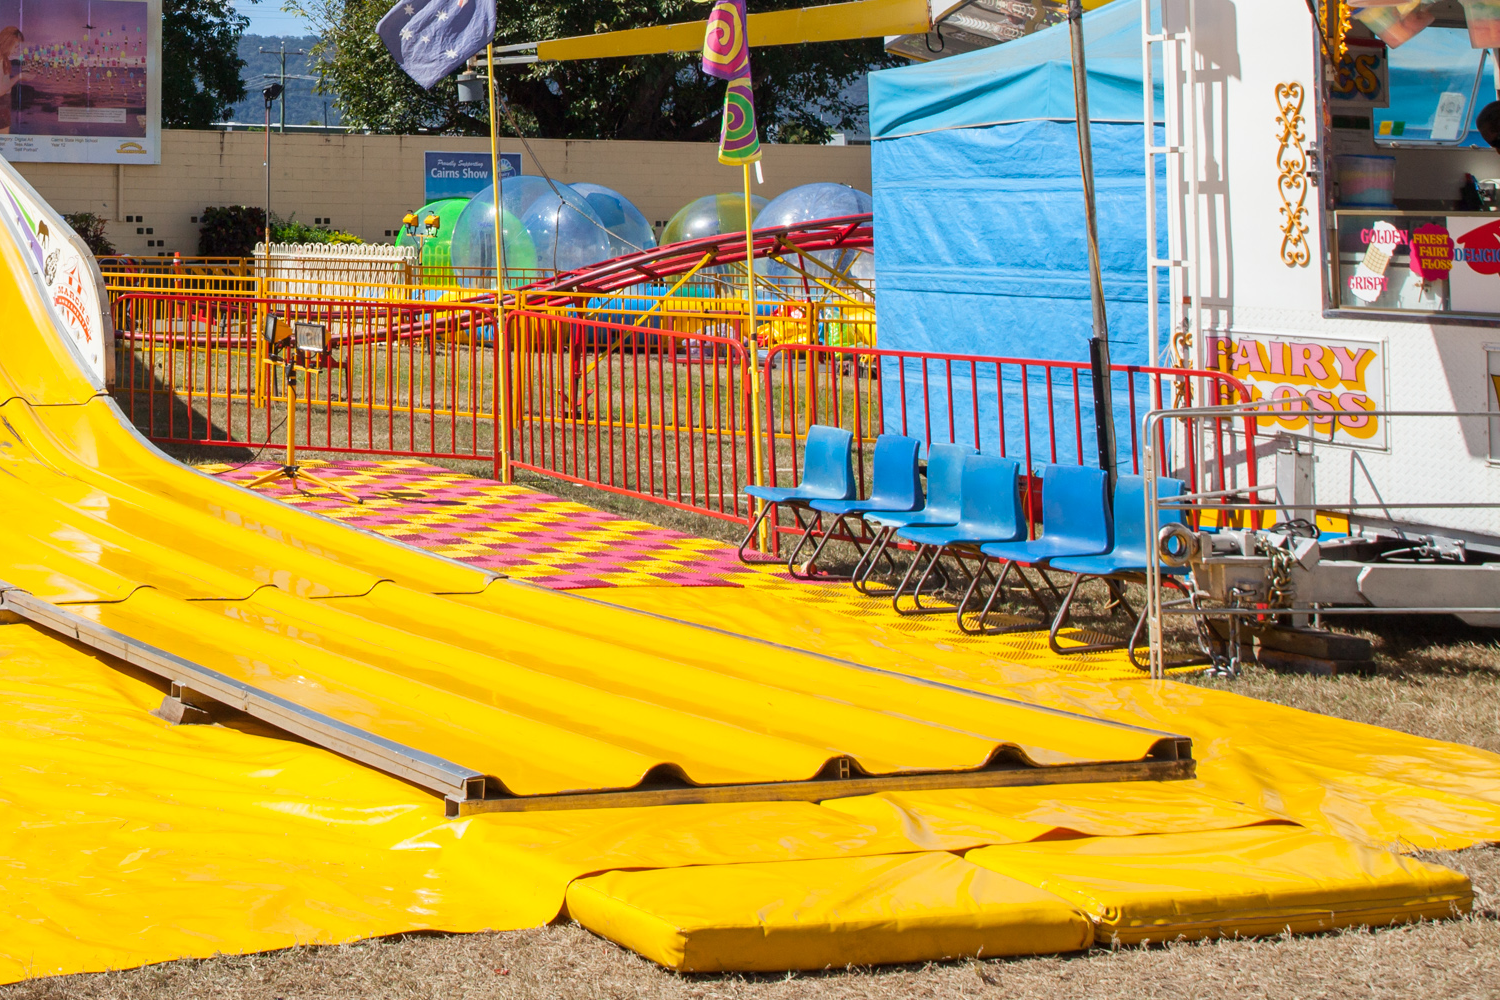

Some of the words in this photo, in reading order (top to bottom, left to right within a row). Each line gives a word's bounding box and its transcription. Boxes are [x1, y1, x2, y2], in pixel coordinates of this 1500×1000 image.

[458, 160, 483, 168] Supporting
[431, 167, 459, 178] Cairns
[463, 168, 488, 178] Show
[1360, 228, 1409, 245] GOLDEN
[1413, 234, 1448, 245] FINEST
[1419, 246, 1449, 257] FAIRY
[1422, 259, 1453, 270] FLOSS
[1348, 276, 1389, 292] CRISPY
[1205, 336, 1370, 382] FAIRY
[1207, 380, 1370, 428] FLOSS
